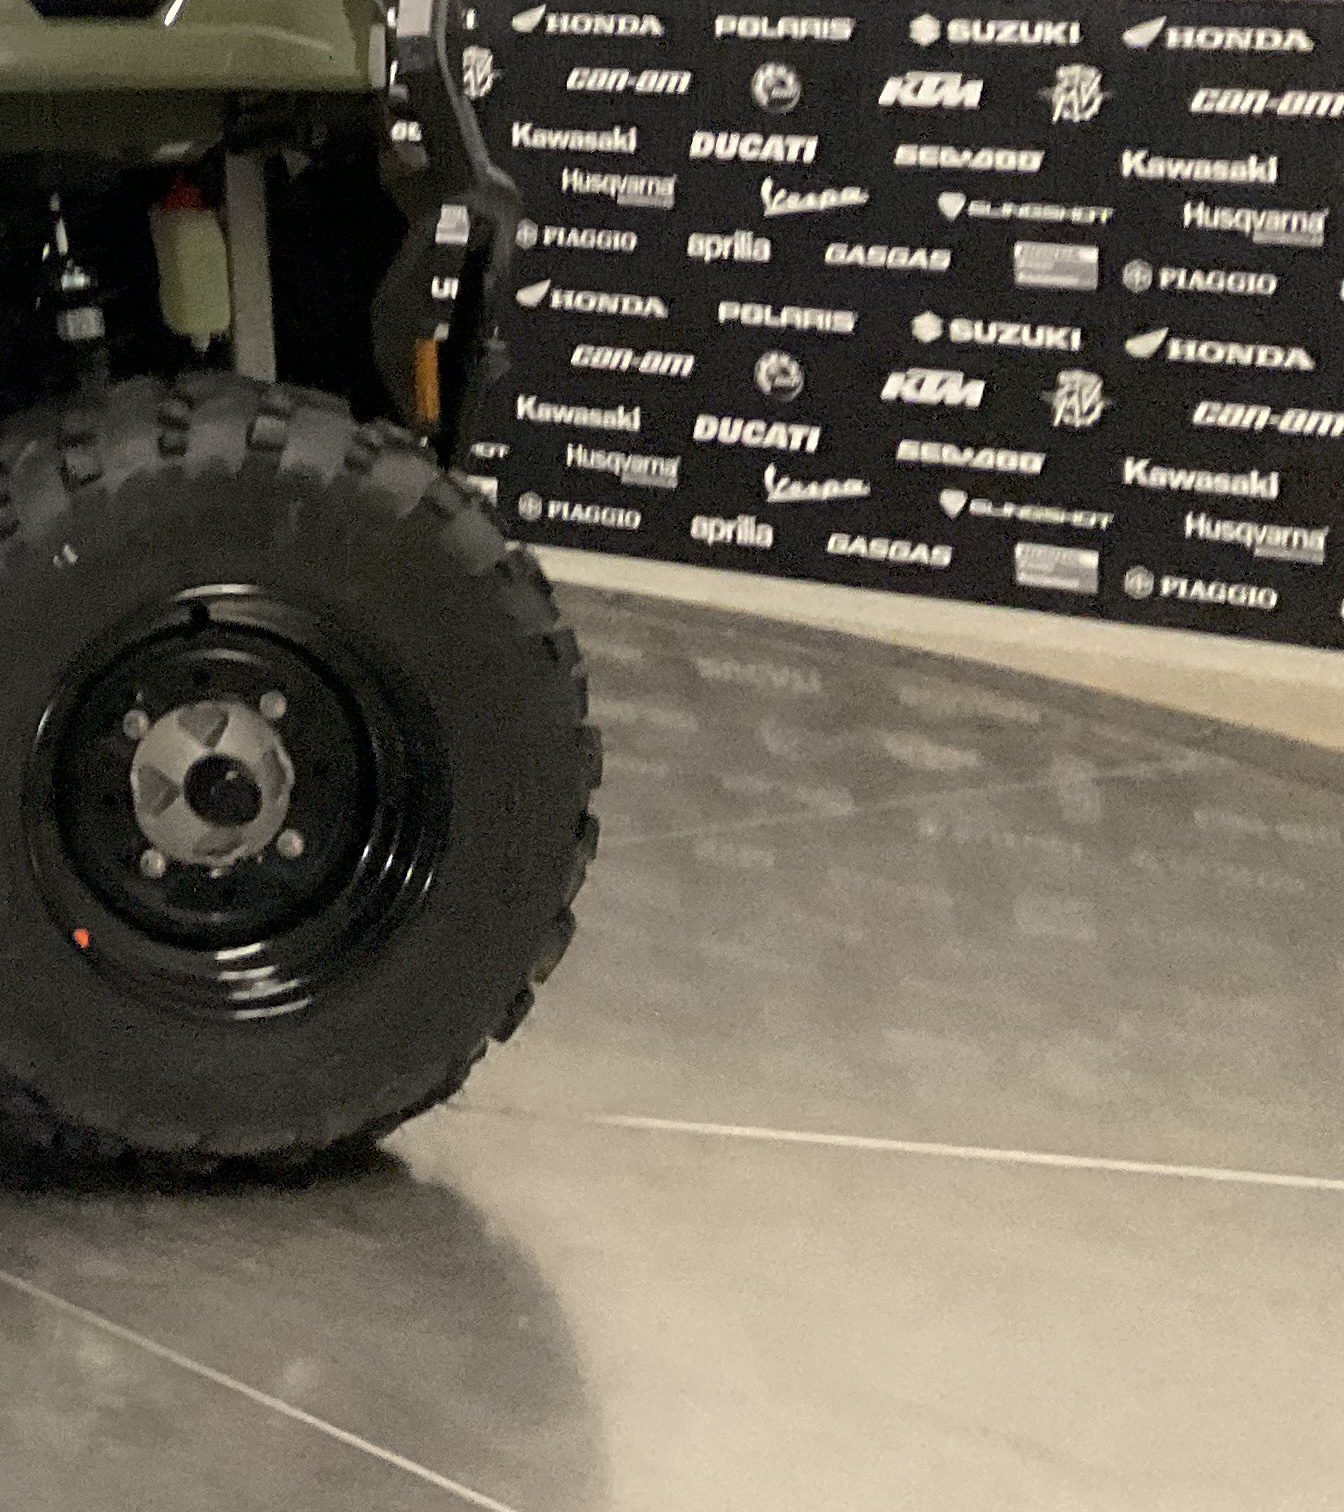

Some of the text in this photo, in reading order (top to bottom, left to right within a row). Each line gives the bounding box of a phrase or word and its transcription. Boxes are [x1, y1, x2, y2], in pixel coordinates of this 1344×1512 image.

[547, 14, 663, 35] HONDA
[715, 16, 853, 40] POLARIS
[948, 19, 1079, 44] SUZUKI
[1166, 27, 1313, 51] HONDA
[879, 72, 983, 107] KTM
[512, 122, 636, 153] Kawasaki
[690, 131, 818, 163] DUCATI
[1122, 150, 1277, 183] Kawasaki
[543, 226, 637, 251] PIAGGIO
[687, 230, 770, 262] aprilia
[825, 243, 950, 271] GASGAS
[1160, 268, 1277, 295] PIAGGIO
[551, 290, 667, 317] HONDA
[718, 302, 857, 332] POLARIS
[950, 319, 1081, 351] SUZUKI
[1168, 338, 1314, 370] HONDA
[881, 368, 985, 407] KTM
[517, 395, 640, 432] Kawasaki
[693, 415, 820, 452] DUCATI
[1124, 457, 1278, 499] Kawasaki
[548, 501, 641, 529] PIAGGIO
[691, 515, 773, 548] aprilia
[826, 533, 952, 567] GASGAS
[1161, 576, 1278, 609] PIAGGIO
